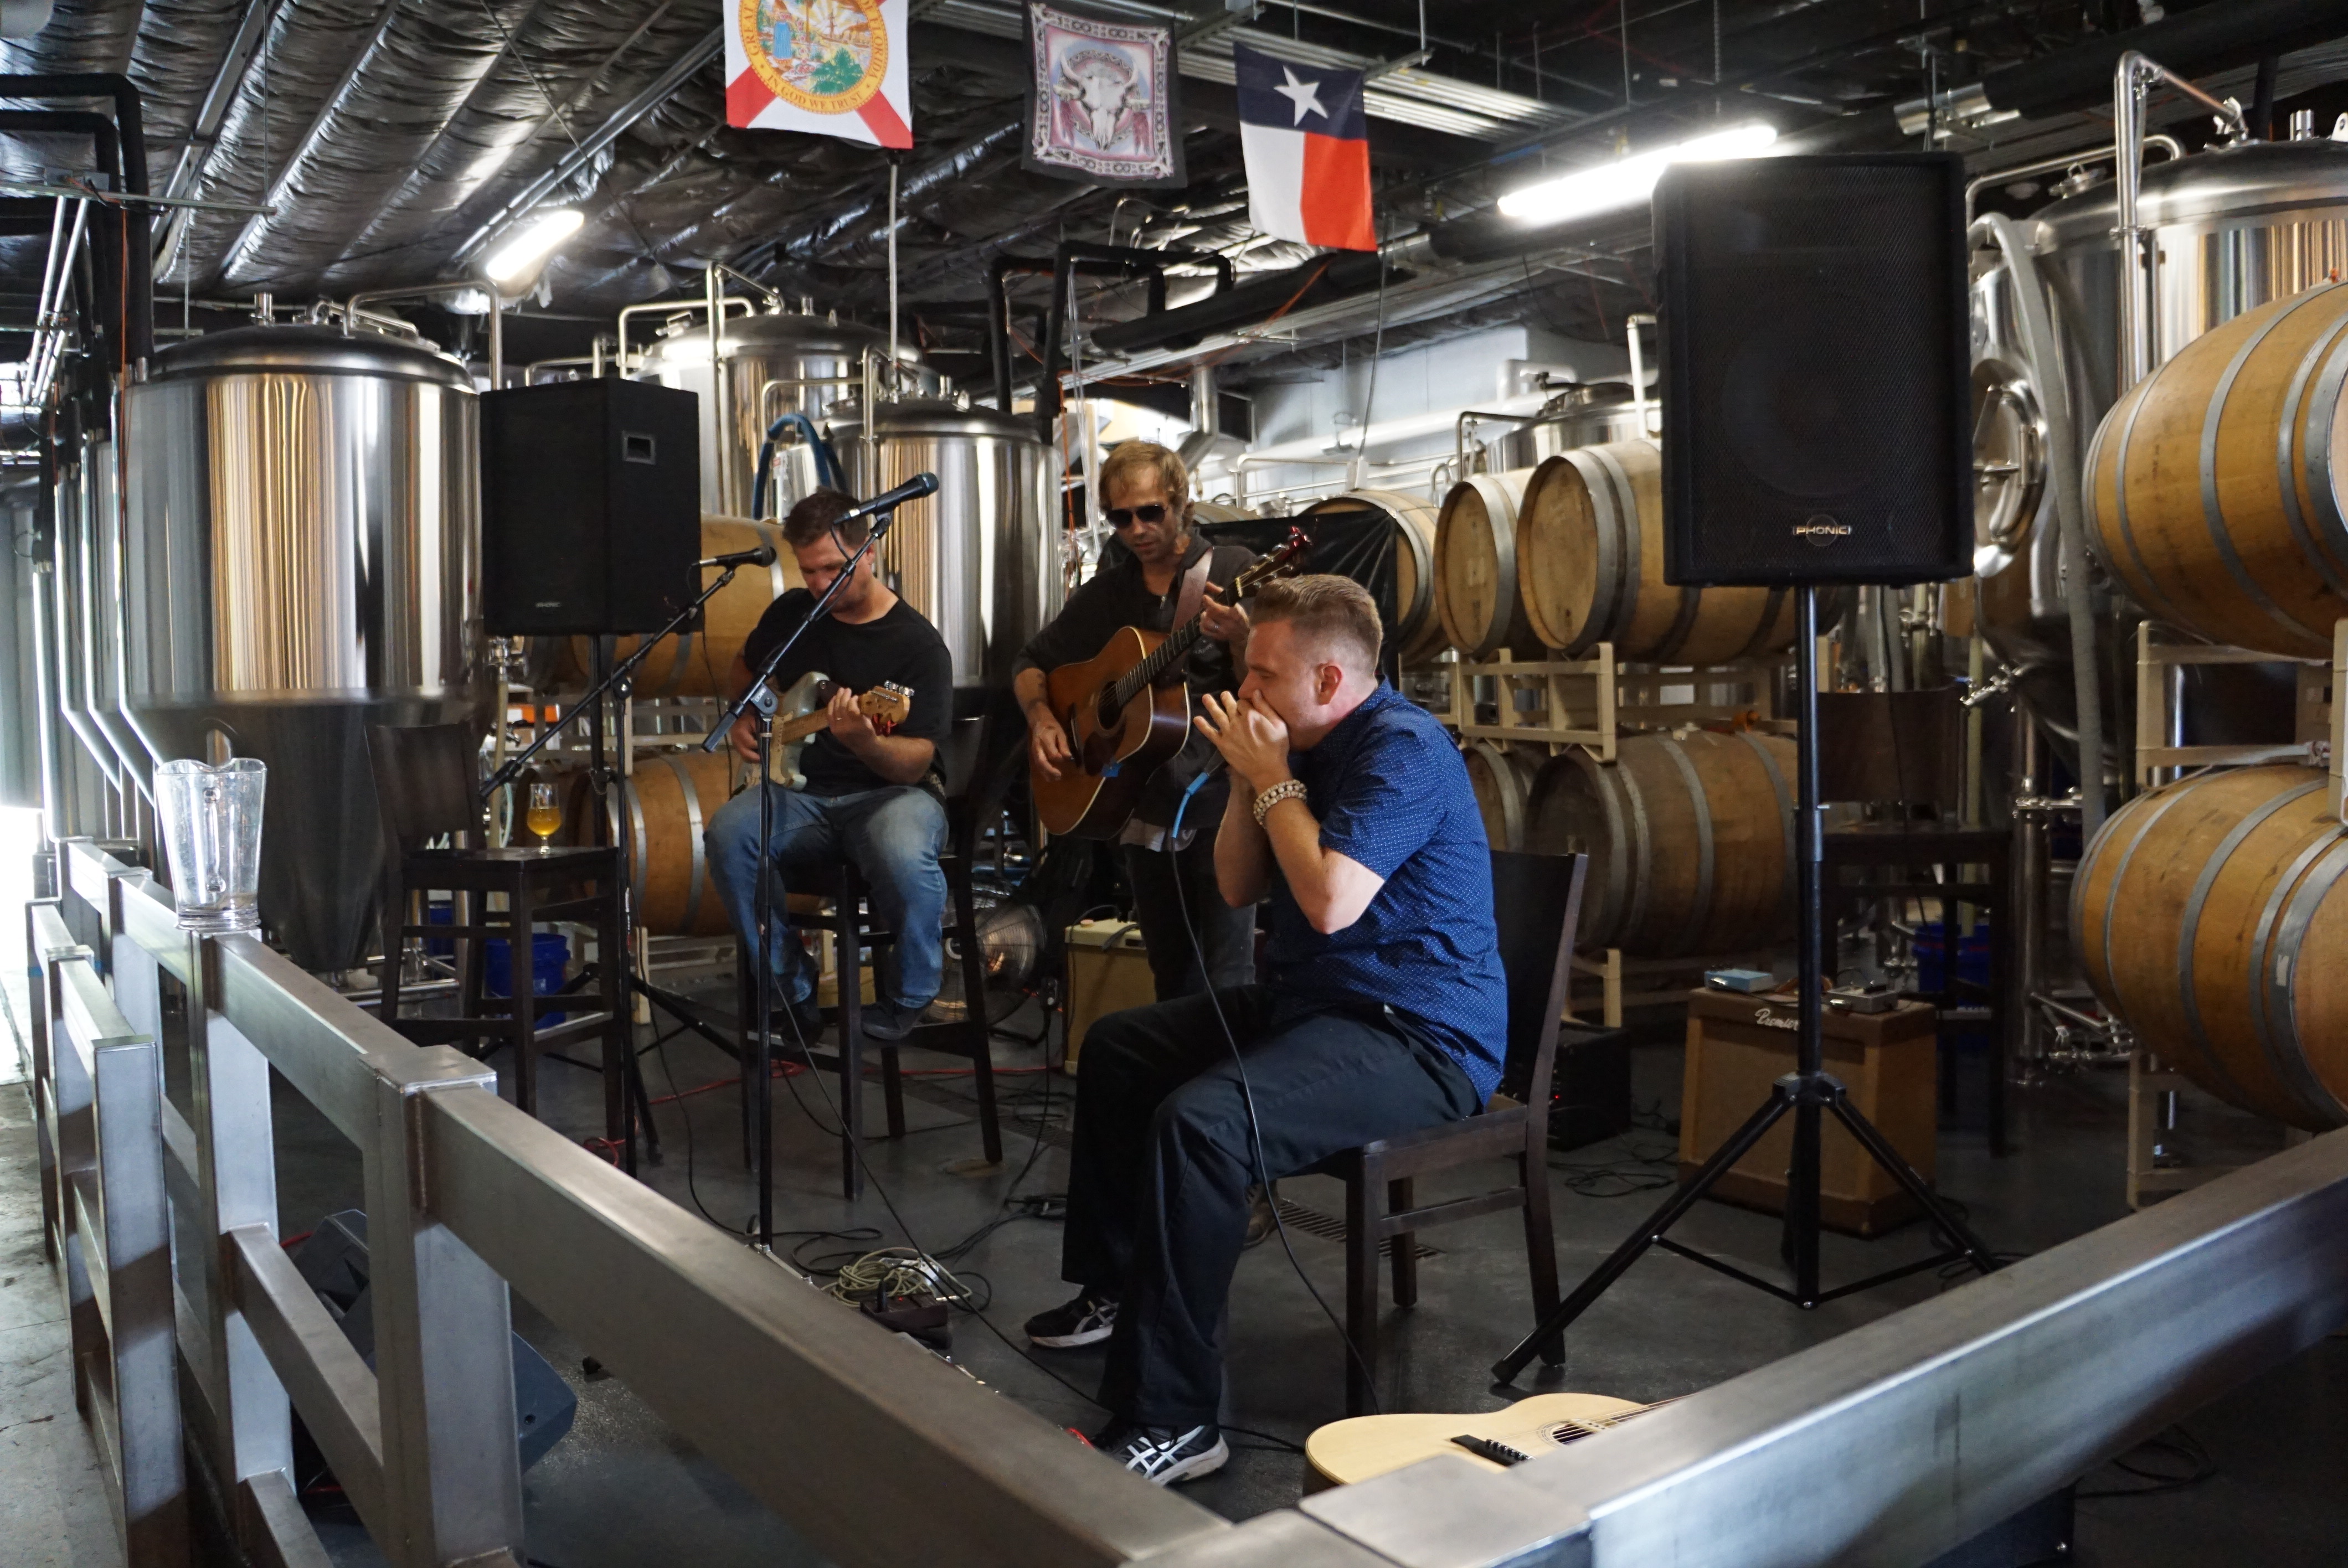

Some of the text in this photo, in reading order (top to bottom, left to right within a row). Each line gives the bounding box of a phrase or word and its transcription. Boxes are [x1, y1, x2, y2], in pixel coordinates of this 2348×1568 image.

[744, 4, 759, 56] GREAT
[869, 18, 883, 78] FLORIDA
[766, 75, 863, 110] IN GOD WE TRUST
[1795, 525, 1848, 535] PHONIC
[1754, 1008, 1799, 1031] Premier
